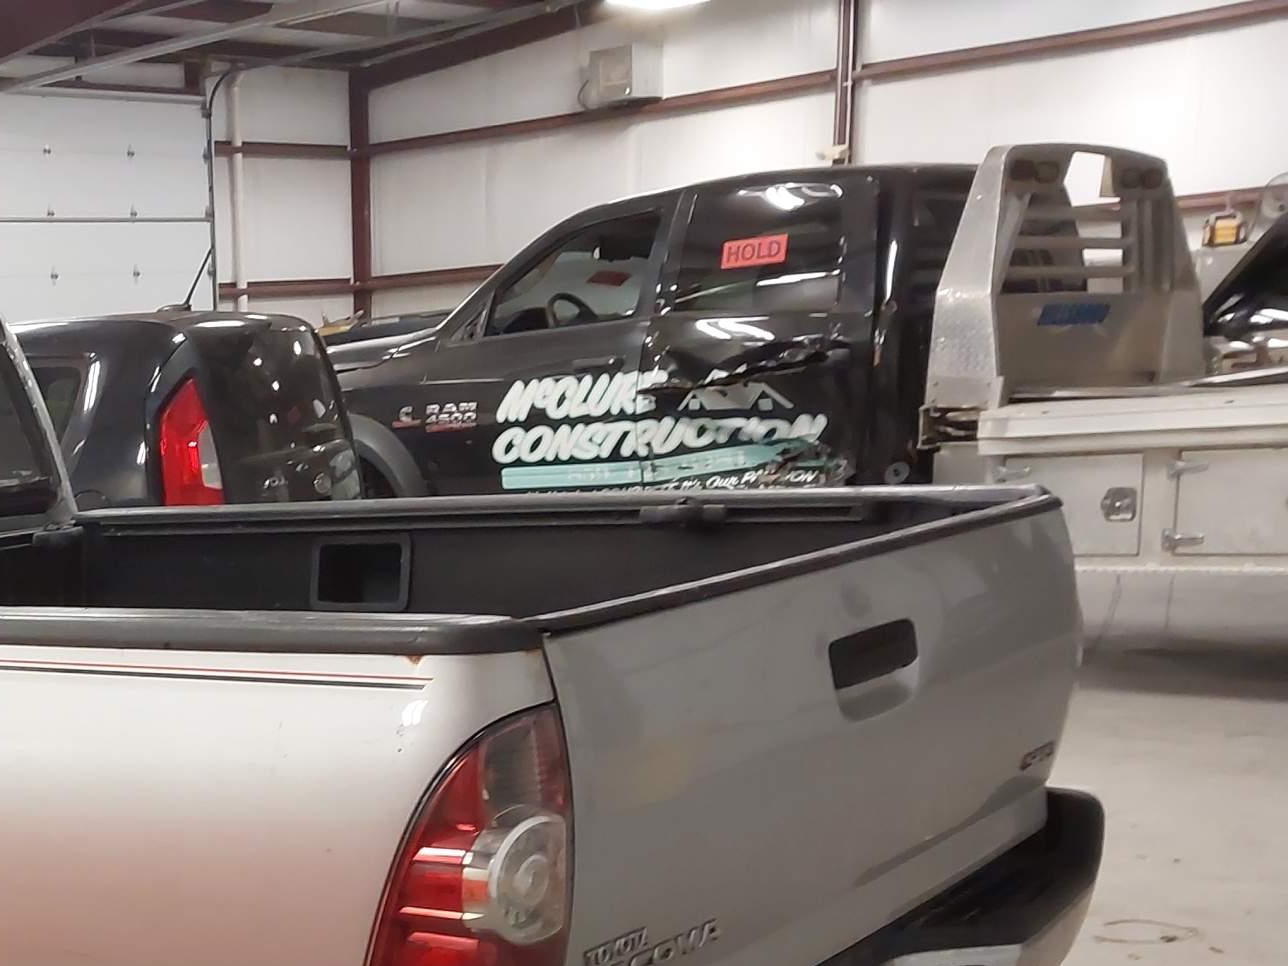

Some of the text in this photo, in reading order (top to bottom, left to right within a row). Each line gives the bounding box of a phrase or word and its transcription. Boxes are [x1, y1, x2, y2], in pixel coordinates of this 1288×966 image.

[726, 241, 781, 263] HOLD
[425, 402, 478, 415] RAM
[492, 413, 828, 464] CONSTRUCTION
